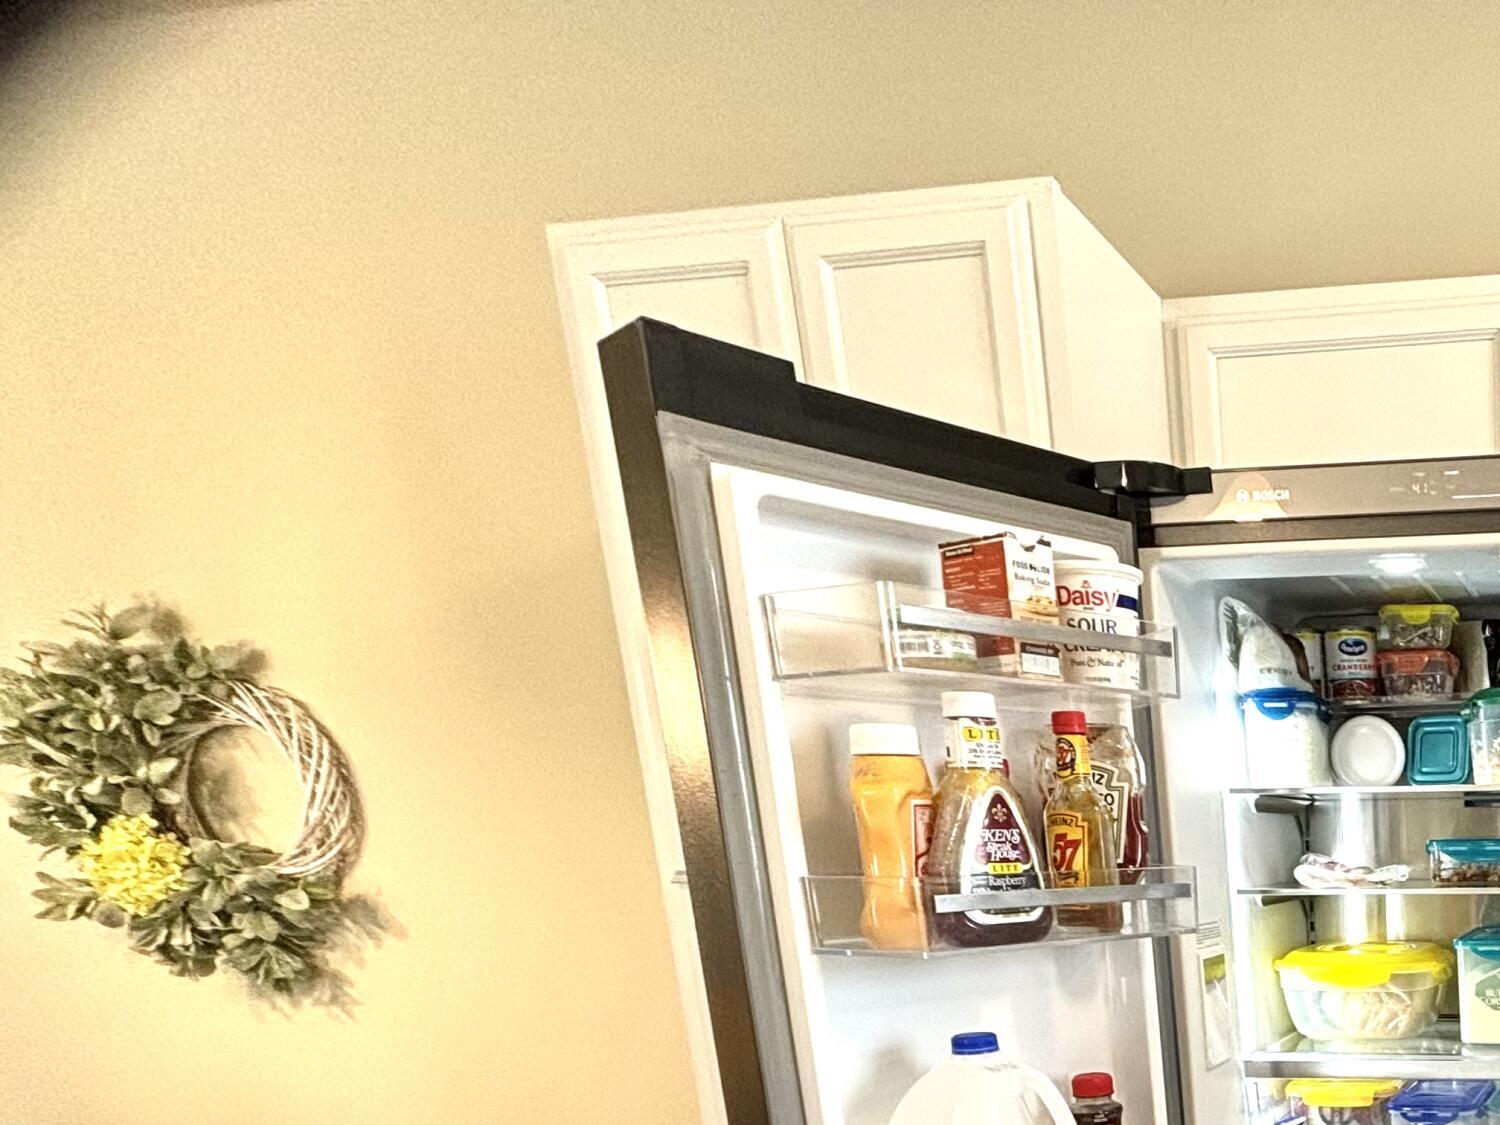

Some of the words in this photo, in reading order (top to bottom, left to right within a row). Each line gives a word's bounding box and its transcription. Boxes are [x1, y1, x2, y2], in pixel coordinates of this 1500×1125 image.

[1056, 585, 1117, 612] Daisy
[1066, 617, 1118, 635] SOUR
[980, 828, 1020, 843] KEN'S
[985, 840, 1012, 853] Steak
[1053, 832, 1082, 871] 57
[991, 849, 1021, 862] House
[992, 863, 1020, 873] LITE
[988, 875, 1027, 888] Raspberry
